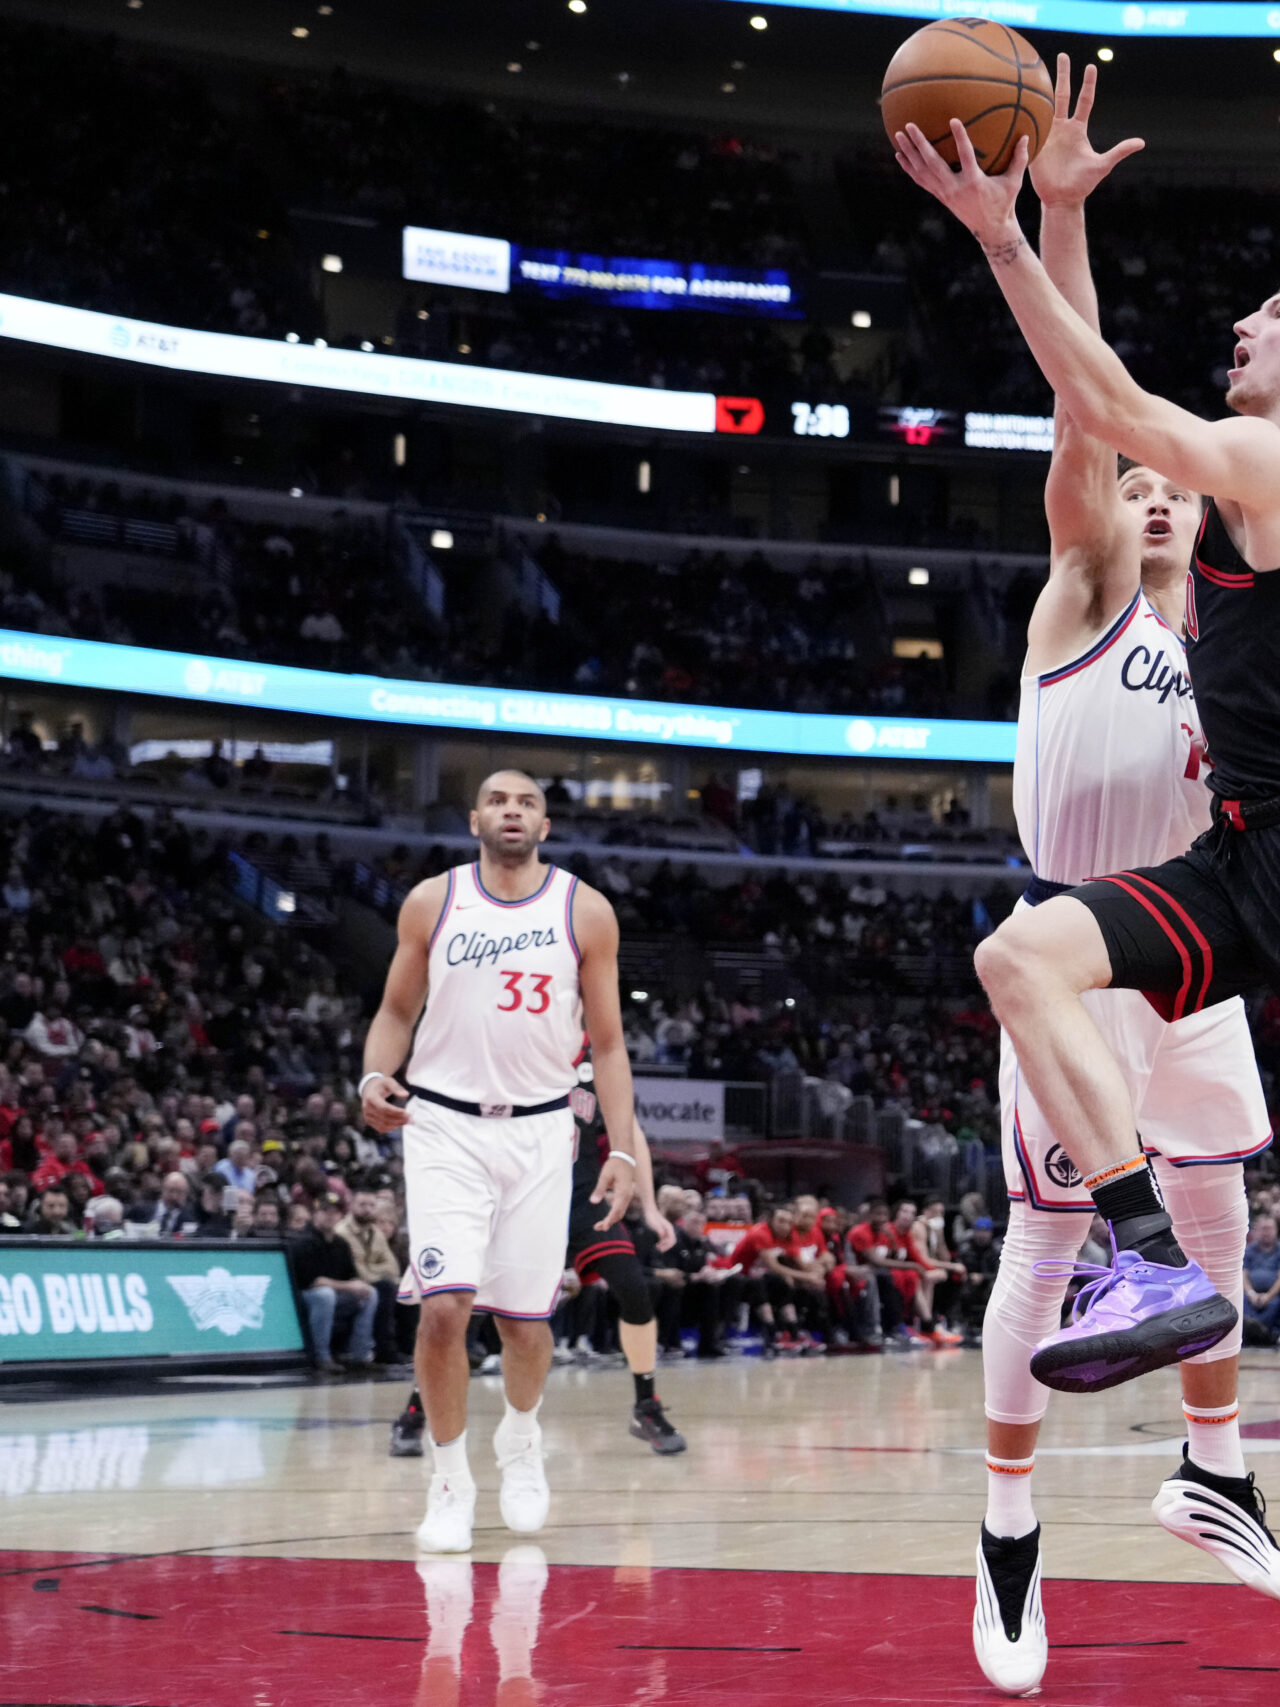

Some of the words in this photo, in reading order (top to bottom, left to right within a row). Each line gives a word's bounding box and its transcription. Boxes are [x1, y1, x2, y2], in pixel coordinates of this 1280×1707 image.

[369, 688, 496, 726] Connecting
[616, 708, 733, 744] Everything
[877, 726, 932, 750] AT&T
[446, 927, 559, 969] Clippers
[497, 970, 554, 1015] 33
[0, 1272, 43, 1336] GO
[43, 1272, 155, 1335] BULLS
